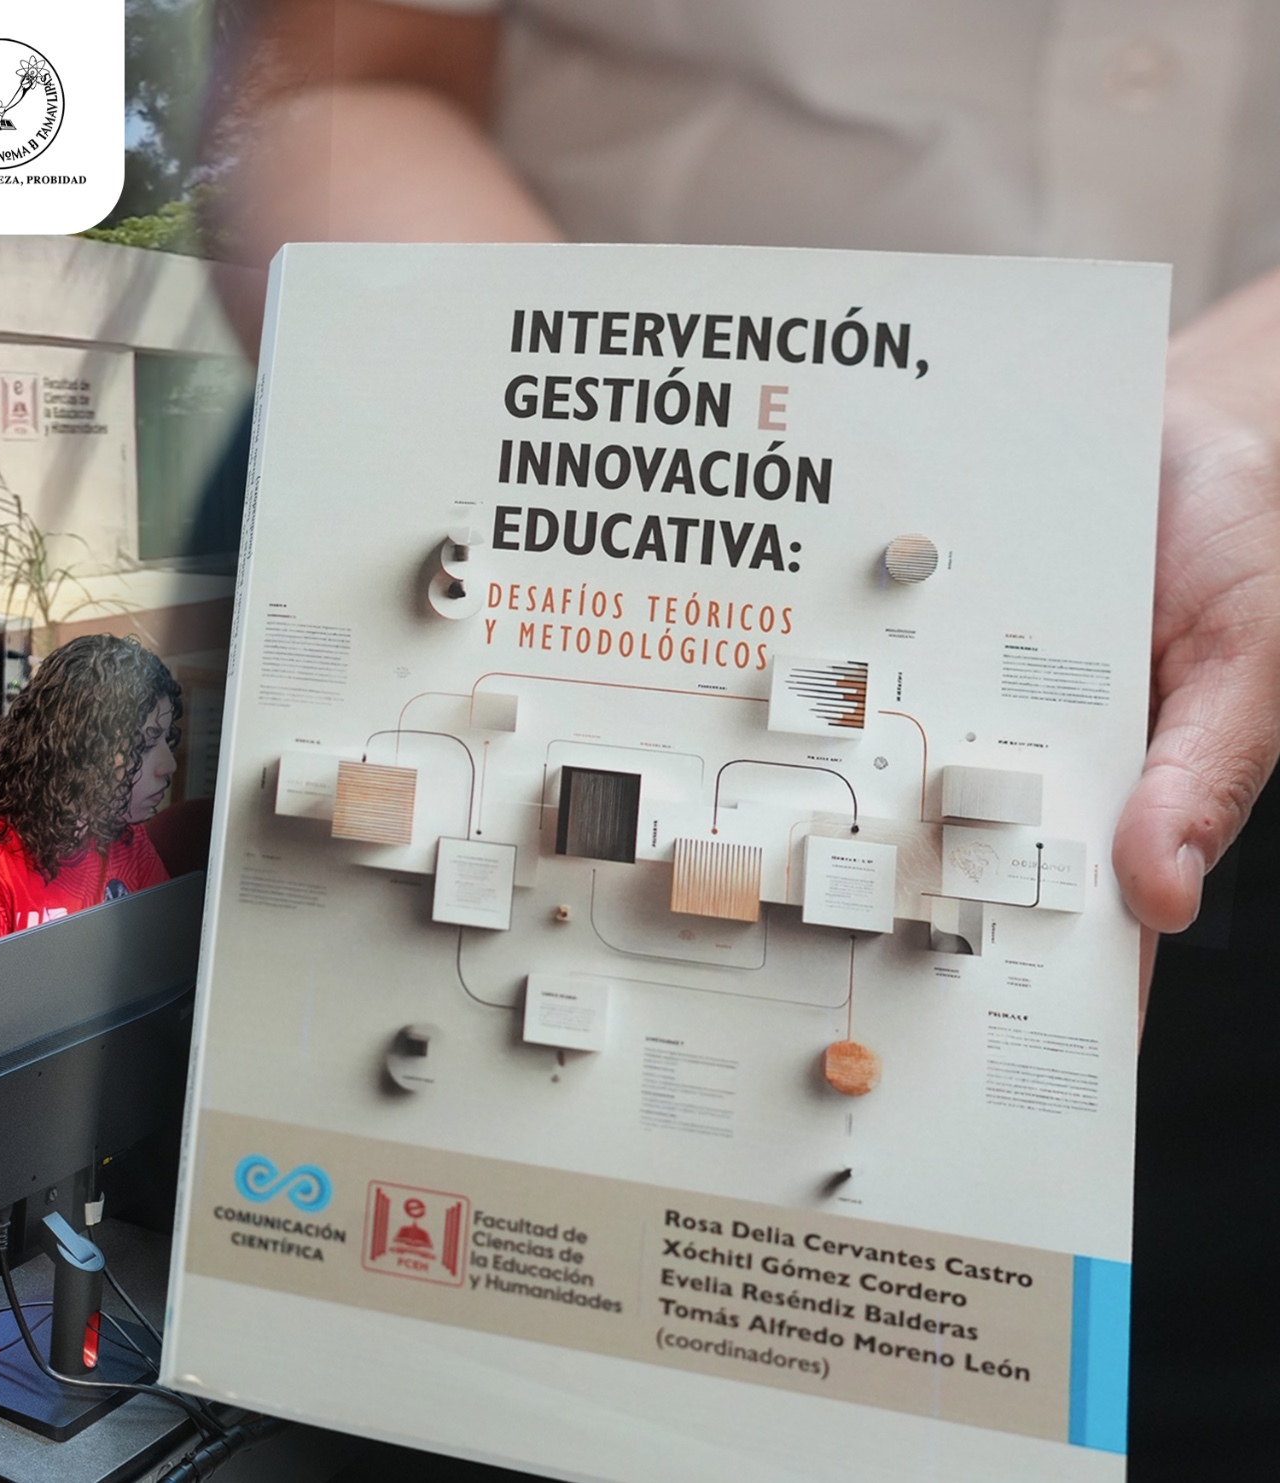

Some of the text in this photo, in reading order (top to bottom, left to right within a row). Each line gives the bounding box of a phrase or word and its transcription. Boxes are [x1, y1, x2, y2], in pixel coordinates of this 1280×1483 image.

[510, 306, 929, 380] INTERVENCIÓN,
[503, 366, 790, 432] GESTIÓN E
[498, 439, 833, 505] INNOVACIÓN
[492, 505, 802, 573] EDUCATIVA:
[488, 582, 794, 635] DESAFÍOS TEÓRICOS
[484, 619, 768, 671] Y METODOLÓGICOS
[213, 1205, 347, 1244] COMUNICACIÓN
[230, 1231, 325, 1263] CIENTÍFICA
[471, 1230, 584, 1266] Ciencias de
[473, 1210, 588, 1246] Facultad de
[664, 1209, 1033, 1289] Rosa Delia Cervantes Castro
[469, 1274, 623, 1314] y Humanidades
[470, 1250, 595, 1288] la Educación
[662, 1239, 968, 1308] Xóchitl Gómez Cordero
[661, 1268, 979, 1342] Evelia Reséndiz Balderas
[655, 1327, 830, 1380] (coordinadores)
[658, 1298, 1031, 1382] Tomás Alfredo Moreno León
